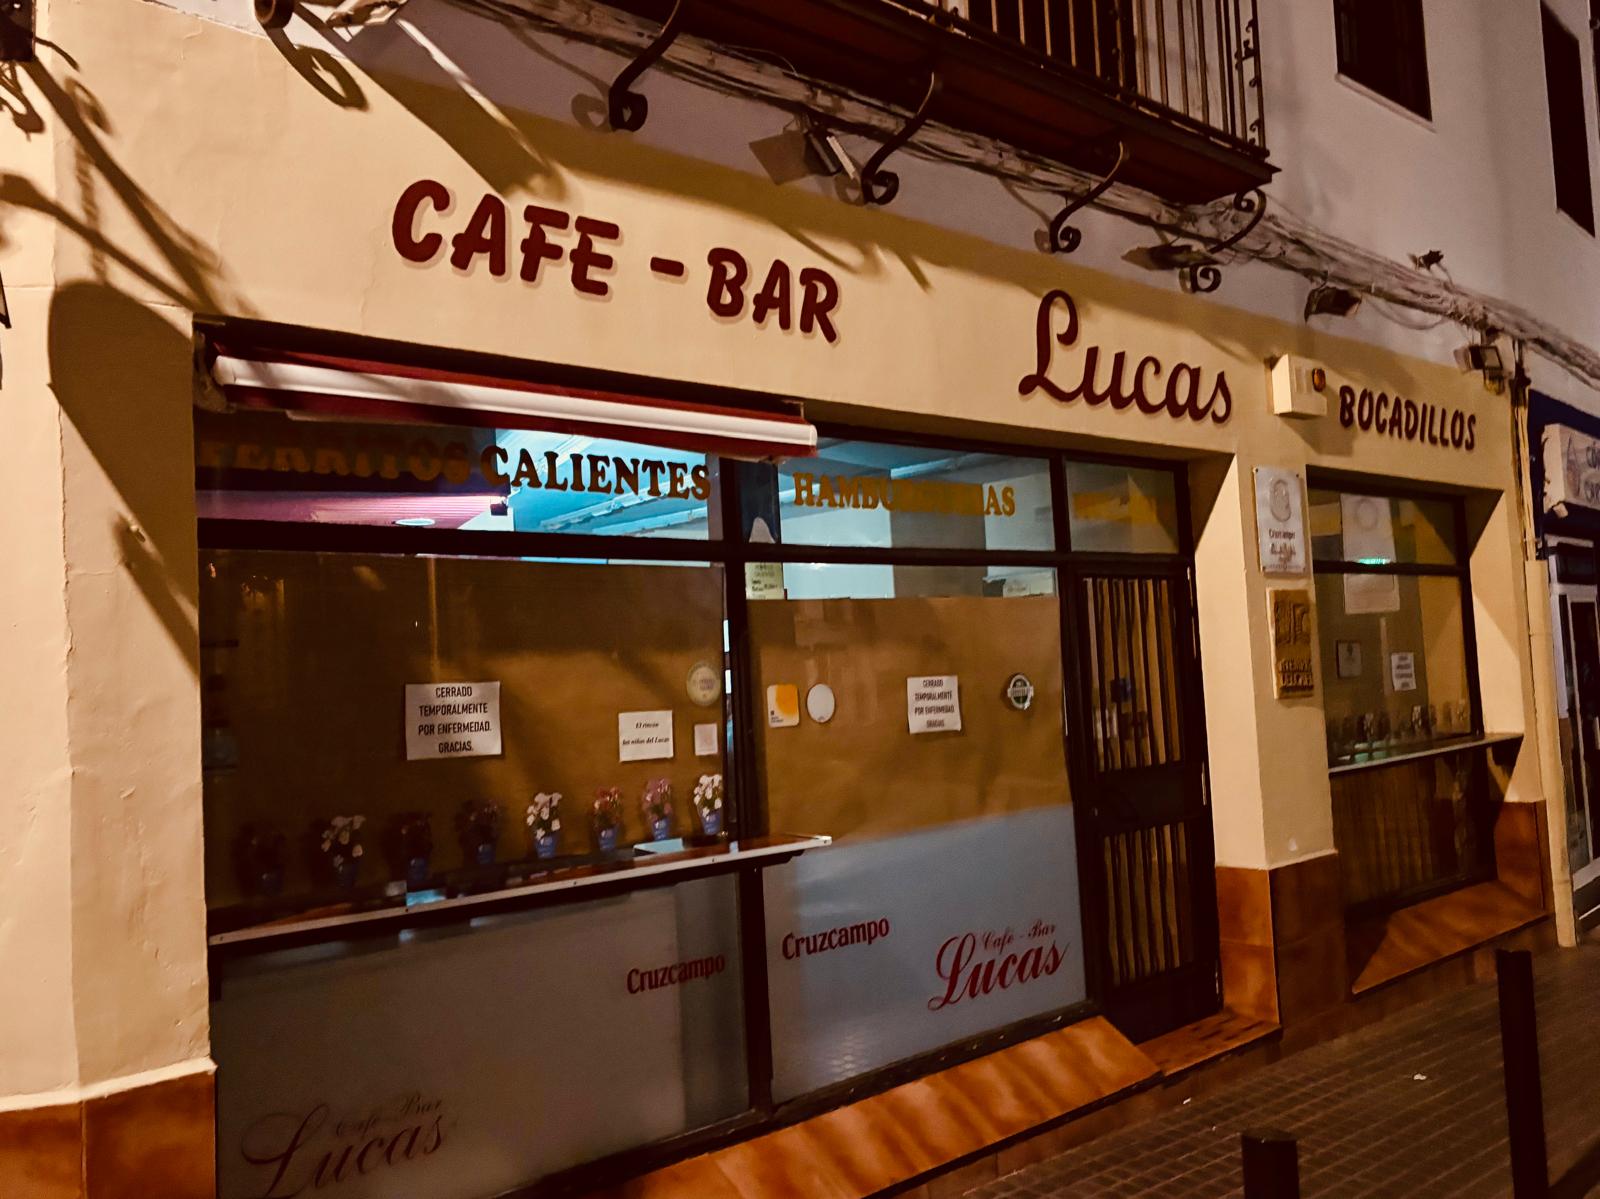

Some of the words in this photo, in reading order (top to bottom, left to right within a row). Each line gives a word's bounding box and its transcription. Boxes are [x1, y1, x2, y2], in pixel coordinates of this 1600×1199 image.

[391, 178, 620, 297] CAFE
[705, 246, 839, 344] BAR
[1018, 288, 1233, 425] Lucas
[1338, 384, 1477, 452] BOCADILLOS
[480, 444, 711, 501] CALIENTES
[418, 702, 488, 717] TEMPORALMENTE
[435, 686, 473, 698] CERRADO
[418, 723, 435, 736] POR
[782, 918, 889, 960] Cruzcampo
[627, 953, 726, 994] Cruzcampo
[927, 932, 1070, 1011] Lucas
[240, 1102, 443, 1199] Lucas
